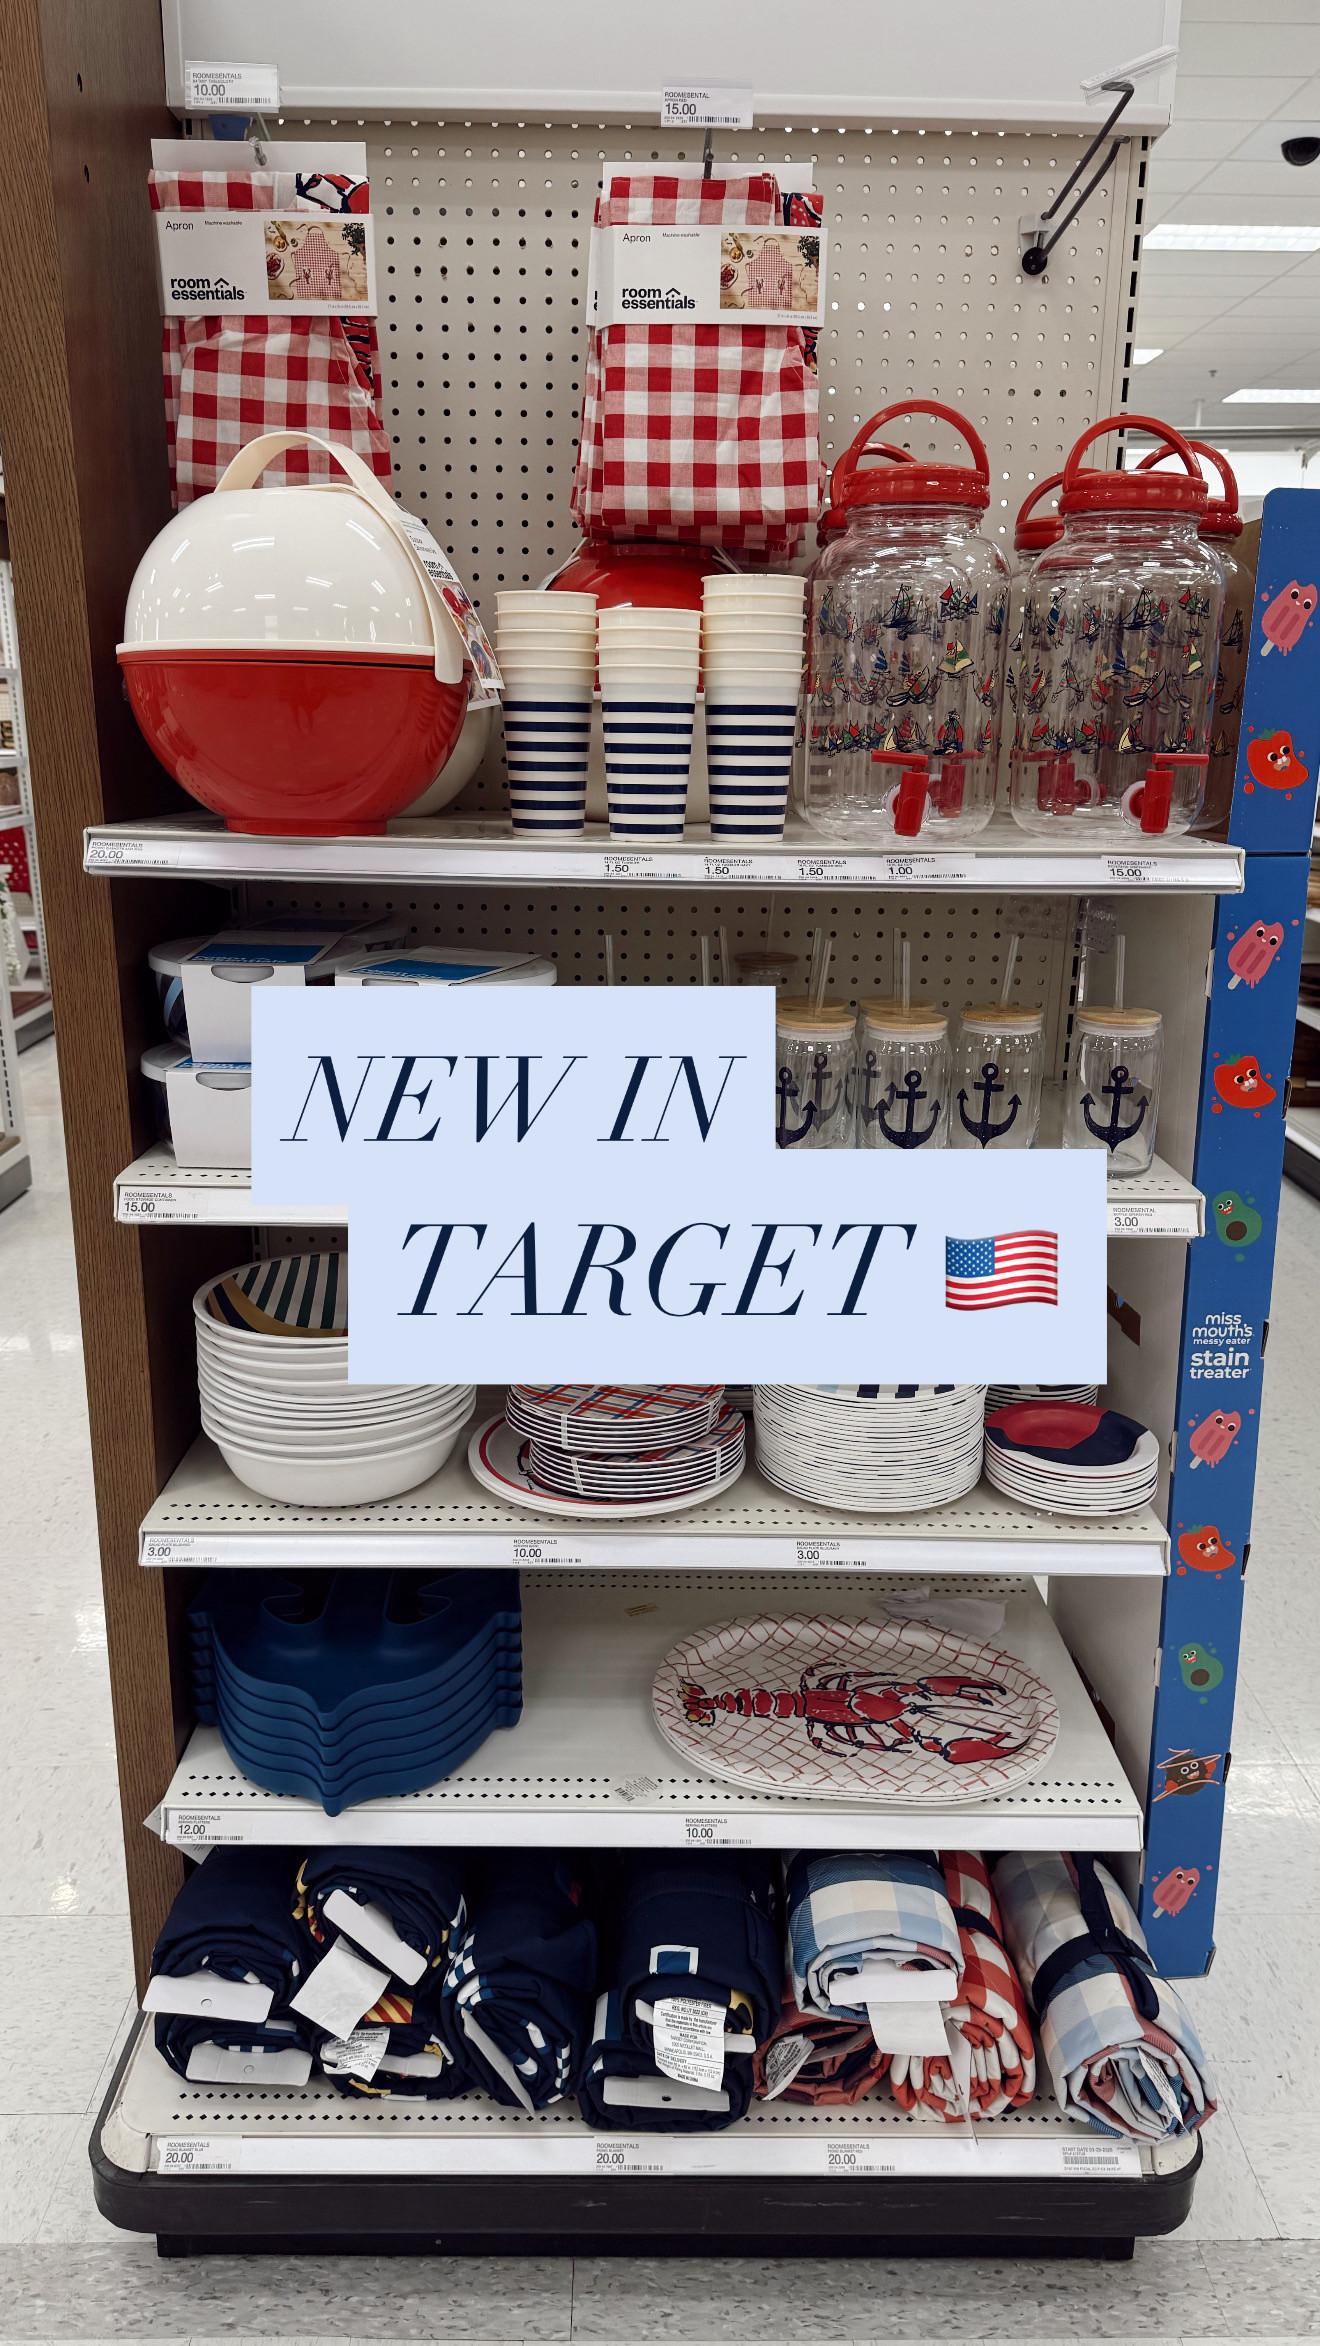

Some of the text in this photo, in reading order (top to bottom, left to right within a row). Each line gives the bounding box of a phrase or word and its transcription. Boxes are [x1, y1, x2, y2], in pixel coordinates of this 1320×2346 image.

[194, 84, 226, 96] 10.00
[666, 104, 697, 115] 15.00
[165, 221, 194, 231] Apron
[622, 233, 651, 243] Apron
[170, 278, 211, 288] room
[171, 285, 245, 300] essentials
[622, 288, 662, 298] room
[622, 295, 696, 309] essentials
[90, 850, 124, 858] 20.00
[605, 864, 629, 872] 1.50
[889, 867, 913, 875] 1.00
[1110, 868, 1142, 877] 15.00
[125, 1202, 155, 1212] 15.00
[1114, 1217, 1139, 1227] 3.00
[1205, 1312, 1242, 1325] miss
[1192, 1323, 1253, 1338] mouth's
[1193, 1338, 1224, 1346] messy
[1191, 1347, 1250, 1366] stain
[1190, 1367, 1250, 1379] treater
[147, 1547, 171, 1556] 3.00
[514, 1548, 542, 1557] 10.00
[797, 1550, 820, 1560] 3.00
[179, 1825, 206, 1834] 12.00
[686, 1828, 713, 1838] 10.00
[165, 2153, 194, 2163] 20.00
[596, 2153, 625, 2163] 20.00
[828, 2154, 856, 2164] 20.00
